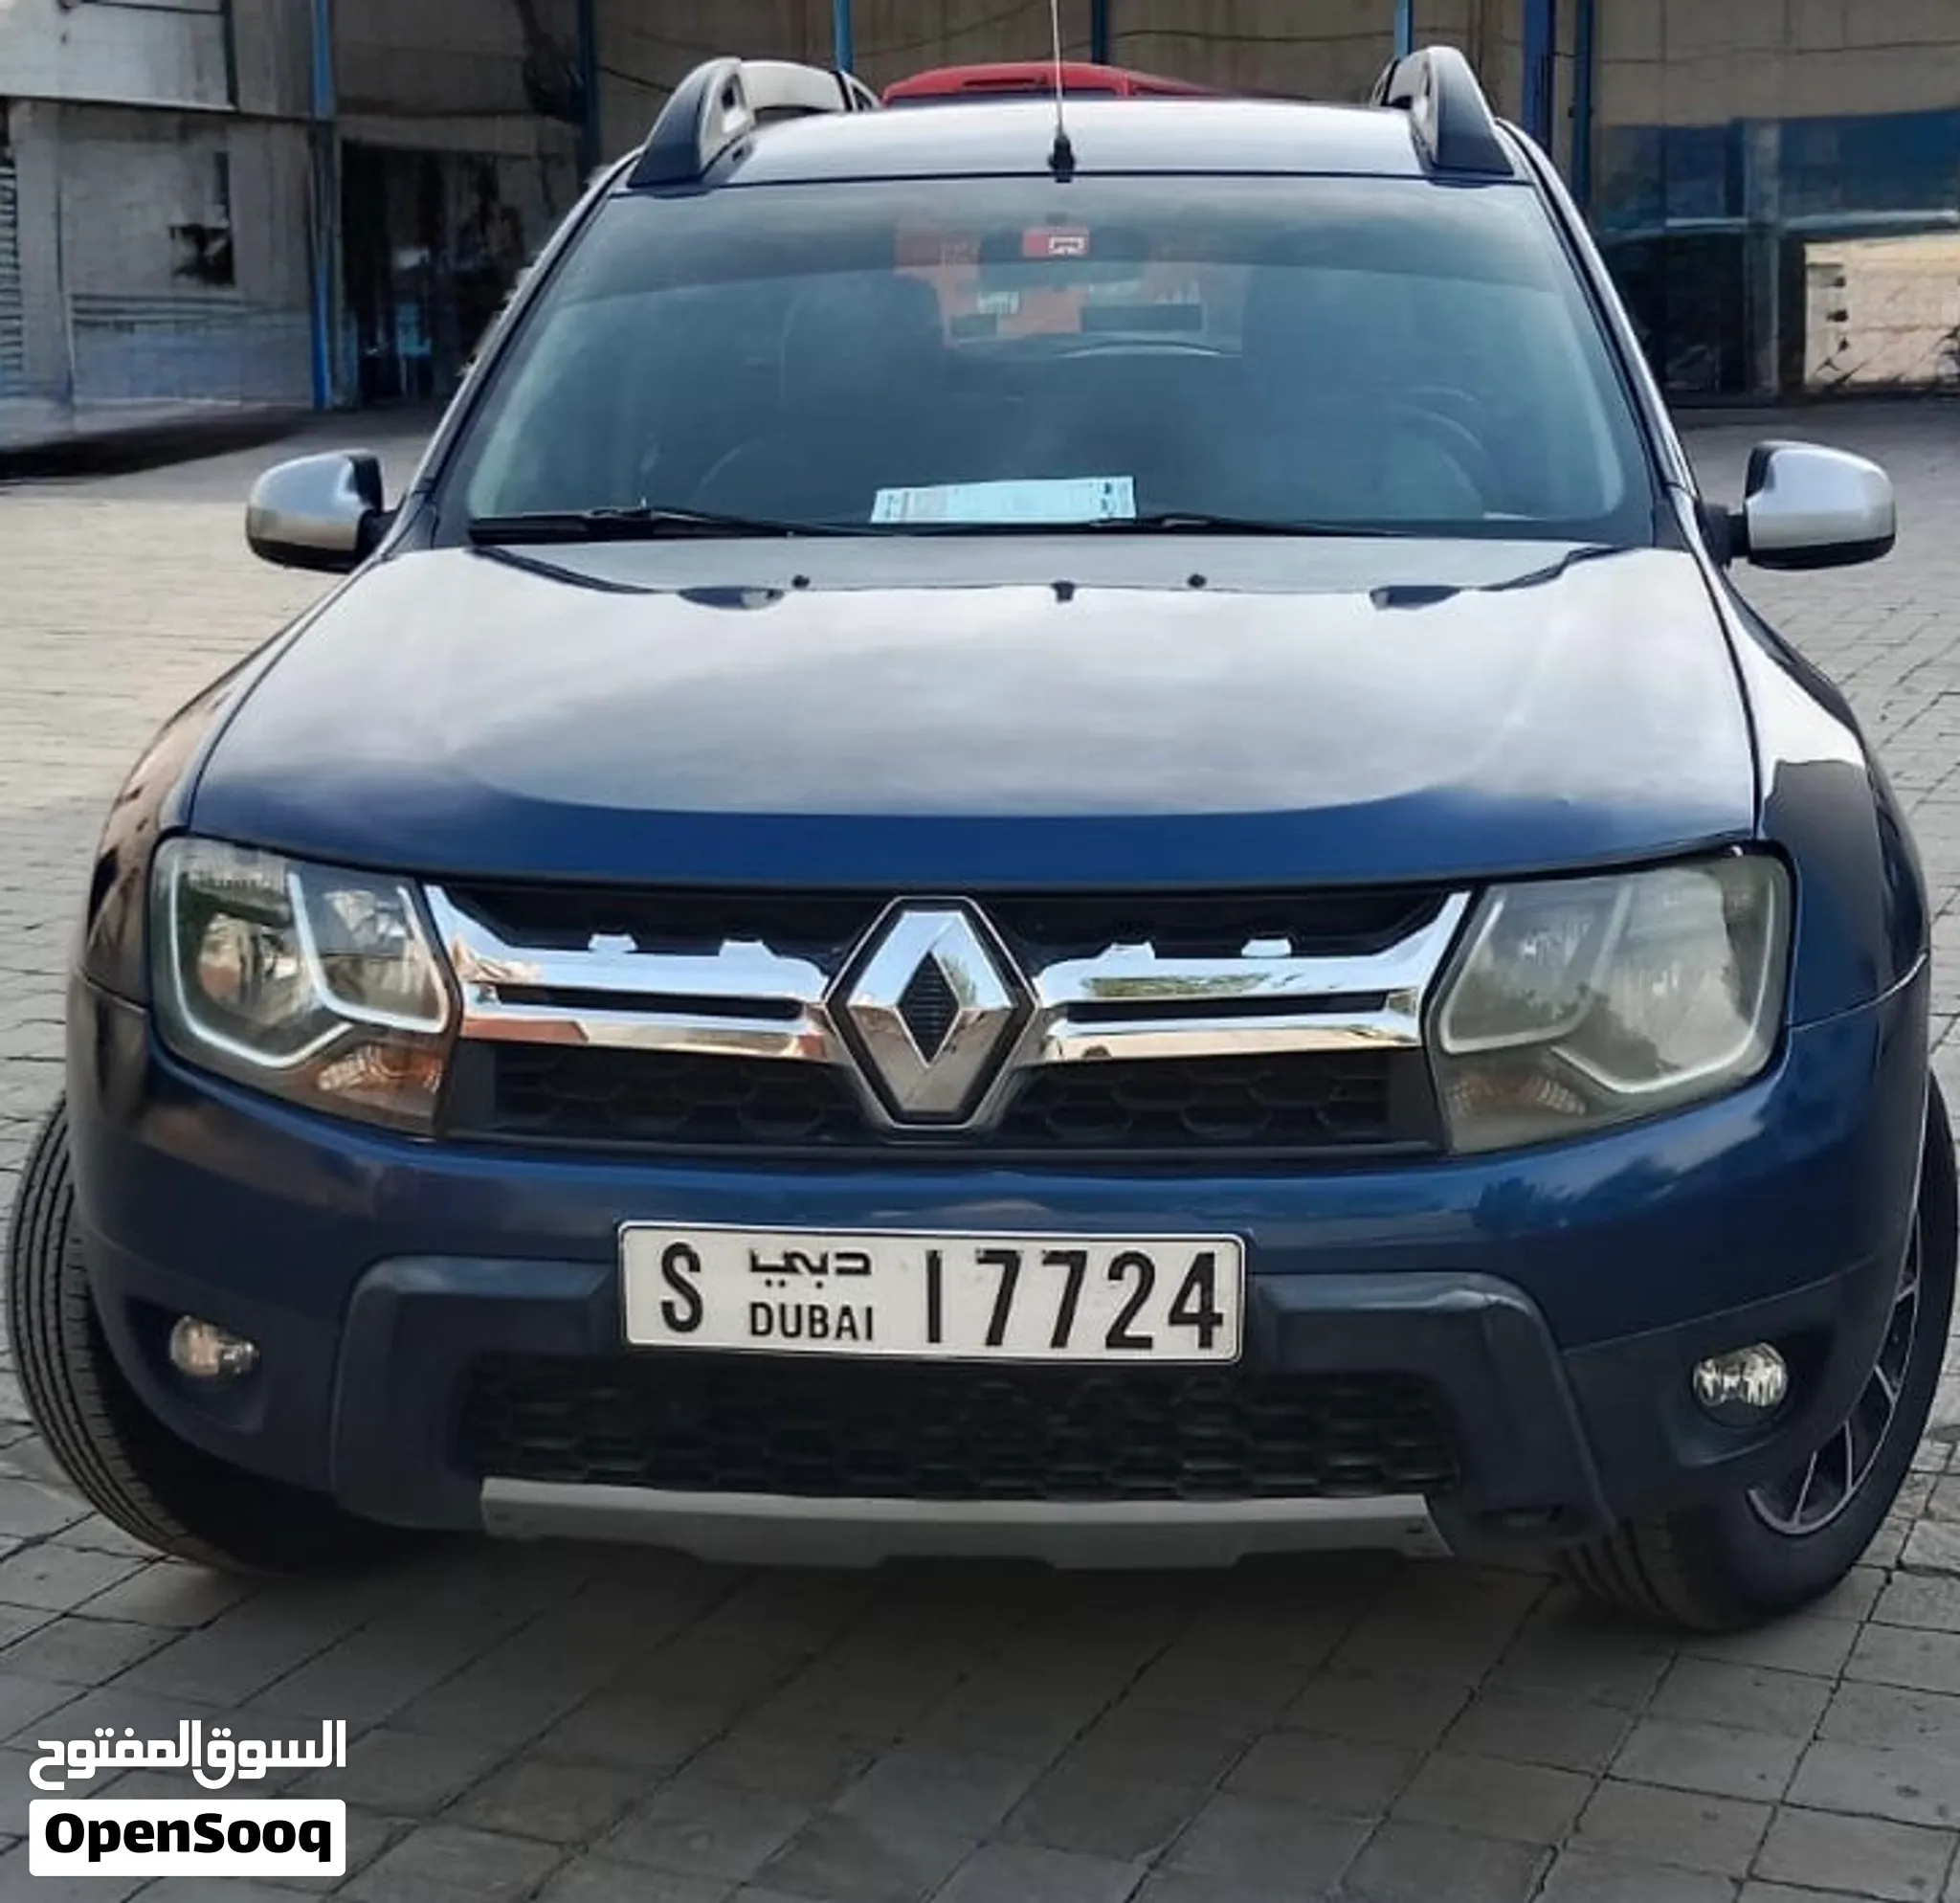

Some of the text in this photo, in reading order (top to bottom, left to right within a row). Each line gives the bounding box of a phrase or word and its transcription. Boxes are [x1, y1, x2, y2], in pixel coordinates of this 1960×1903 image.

[661, 1243, 702, 1332] S
[749, 1250, 872, 1288] دبي
[926, 1249, 1223, 1350] 17724
[750, 1302, 873, 1340] DUBAI
